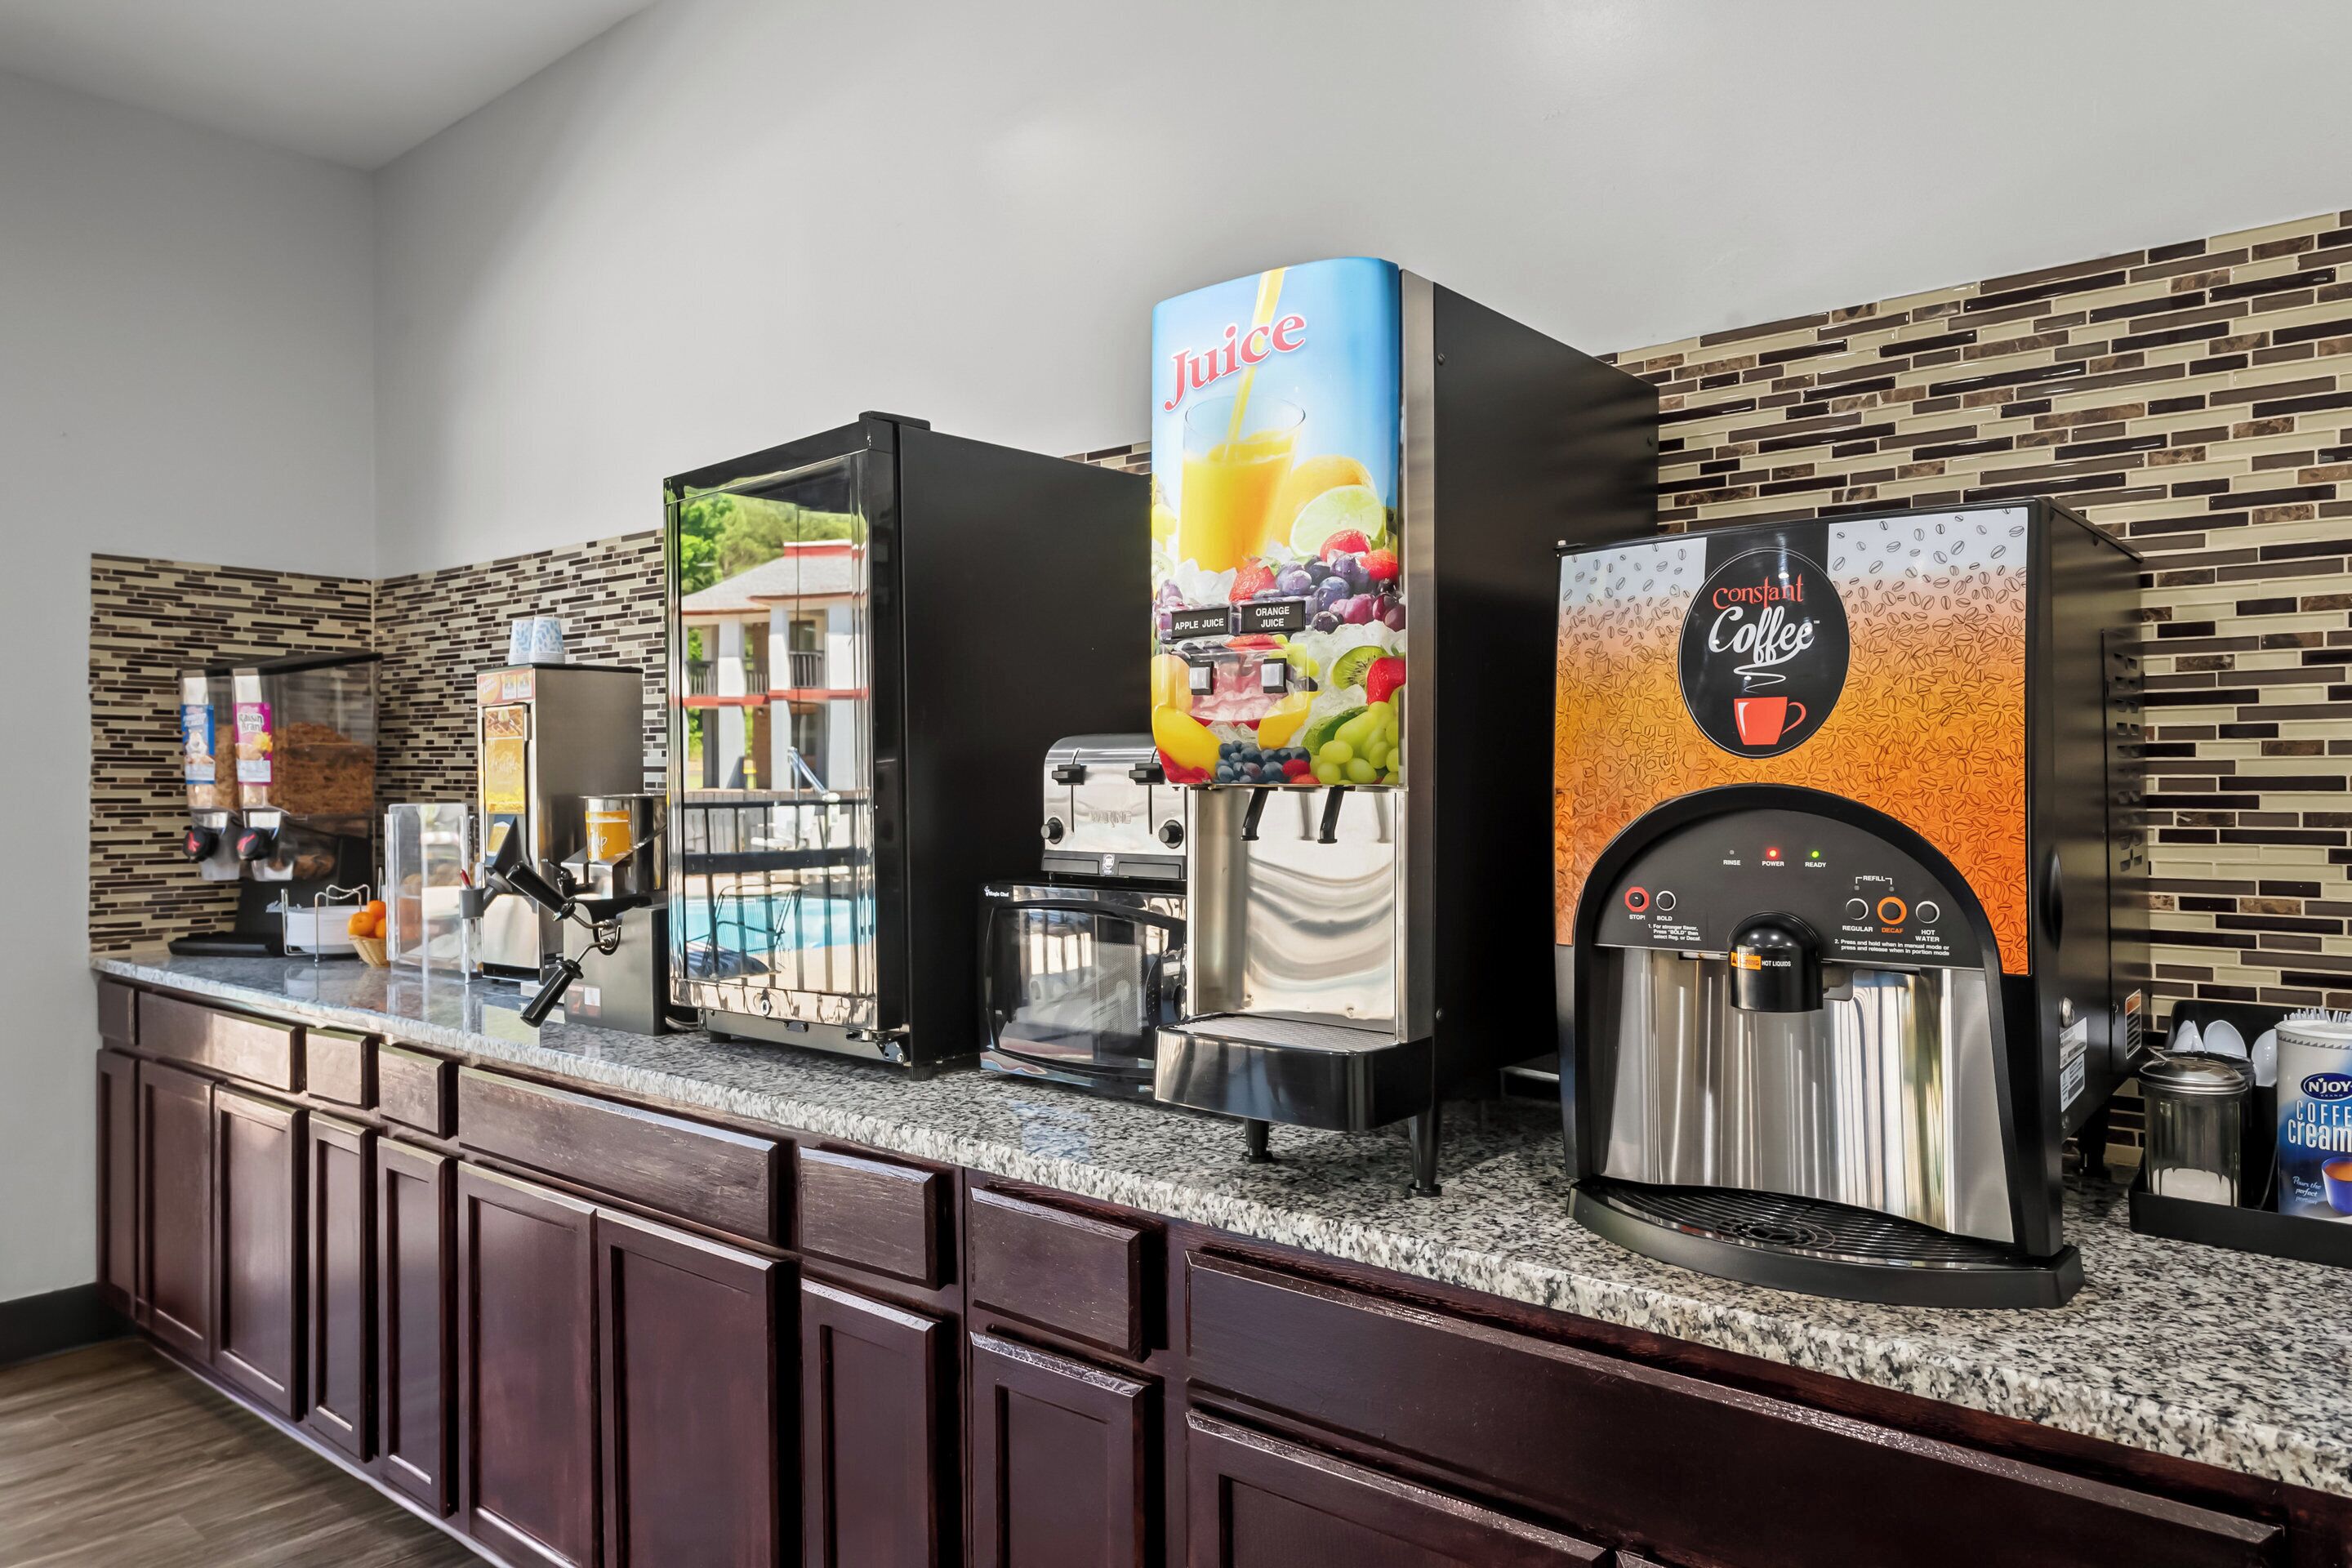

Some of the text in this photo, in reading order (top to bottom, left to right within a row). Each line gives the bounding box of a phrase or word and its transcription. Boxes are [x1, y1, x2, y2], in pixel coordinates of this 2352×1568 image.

[1165, 315, 1305, 411] Juice
[1713, 573, 1804, 610] constant
[1255, 606, 1290, 617] ORANGE
[1174, 618, 1224, 630] APPLE JUICE
[1261, 618, 1285, 628] JUICE
[1708, 605, 1815, 665] Coffee
[2292, 1175, 2322, 1190] Pours the
[2295, 1187, 2318, 1197] perfect
